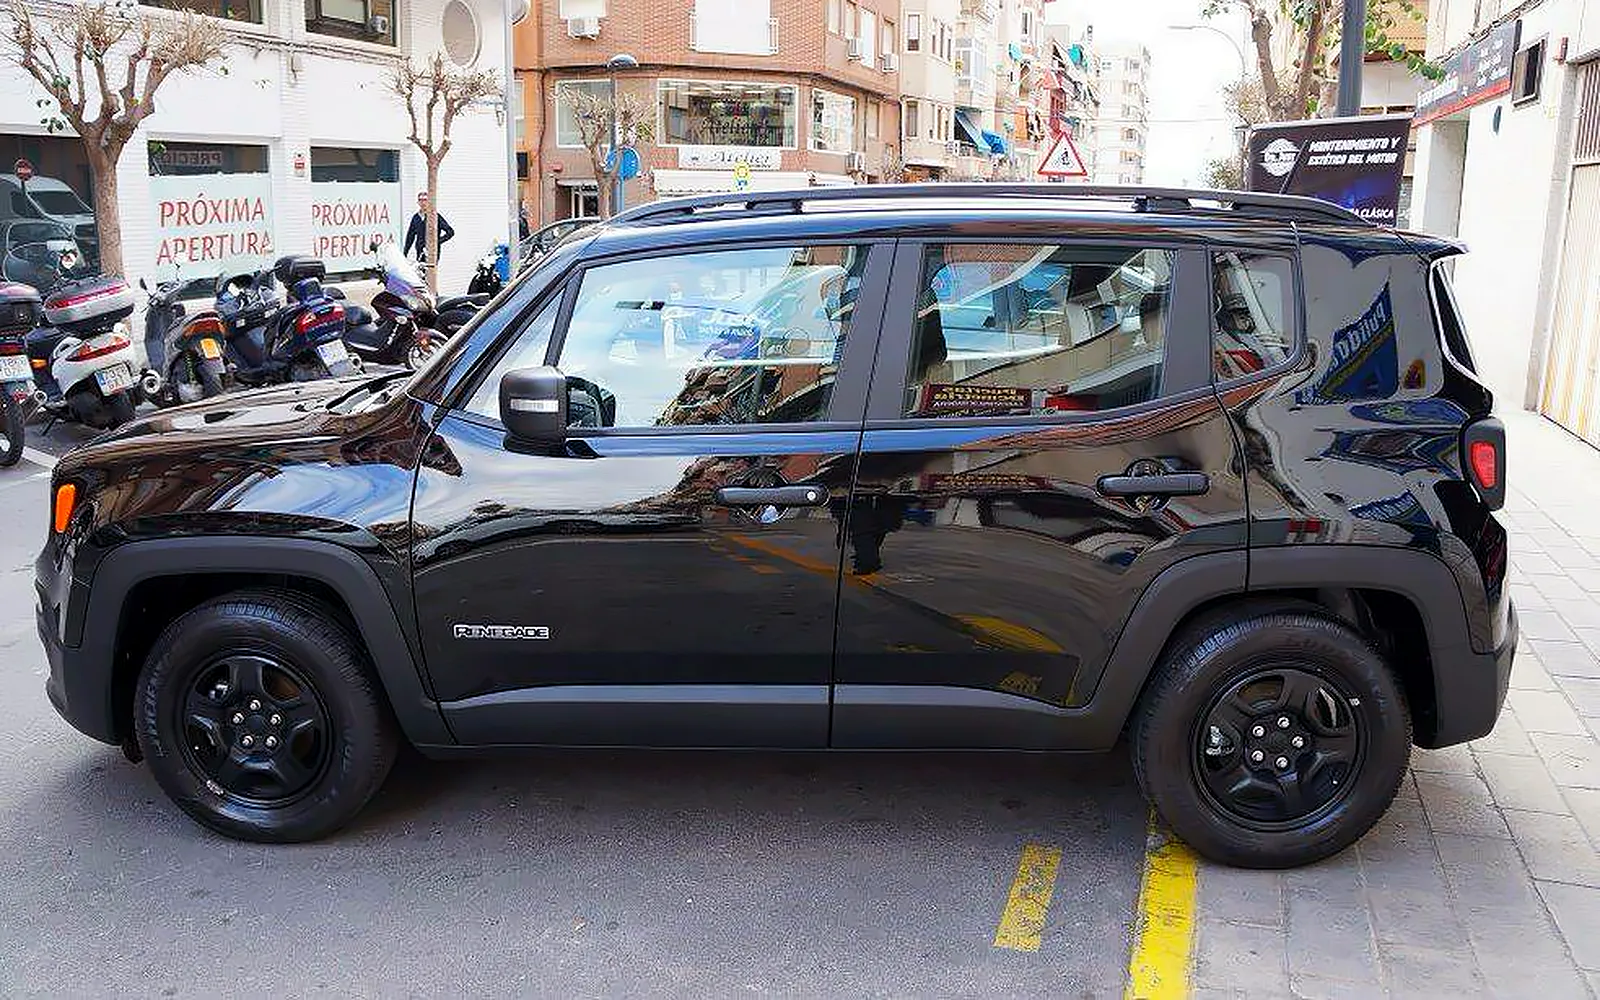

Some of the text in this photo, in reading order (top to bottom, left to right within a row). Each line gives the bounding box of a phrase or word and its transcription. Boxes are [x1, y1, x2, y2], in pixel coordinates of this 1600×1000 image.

[1308, 136, 1401, 152] MANTENIMIENTO Y
[1308, 152, 1347, 165] ESTÉTICA
[1348, 154, 1365, 164] DEL
[1366, 152, 1398, 164] MOTOR
[159, 192, 265, 228] PRÓXIMA
[312, 197, 390, 227] PRÓXIMA
[1361, 207, 1395, 219] CLÁSICA
[156, 229, 274, 266] APERTURA
[454, 624, 550, 640] RENEGADE
